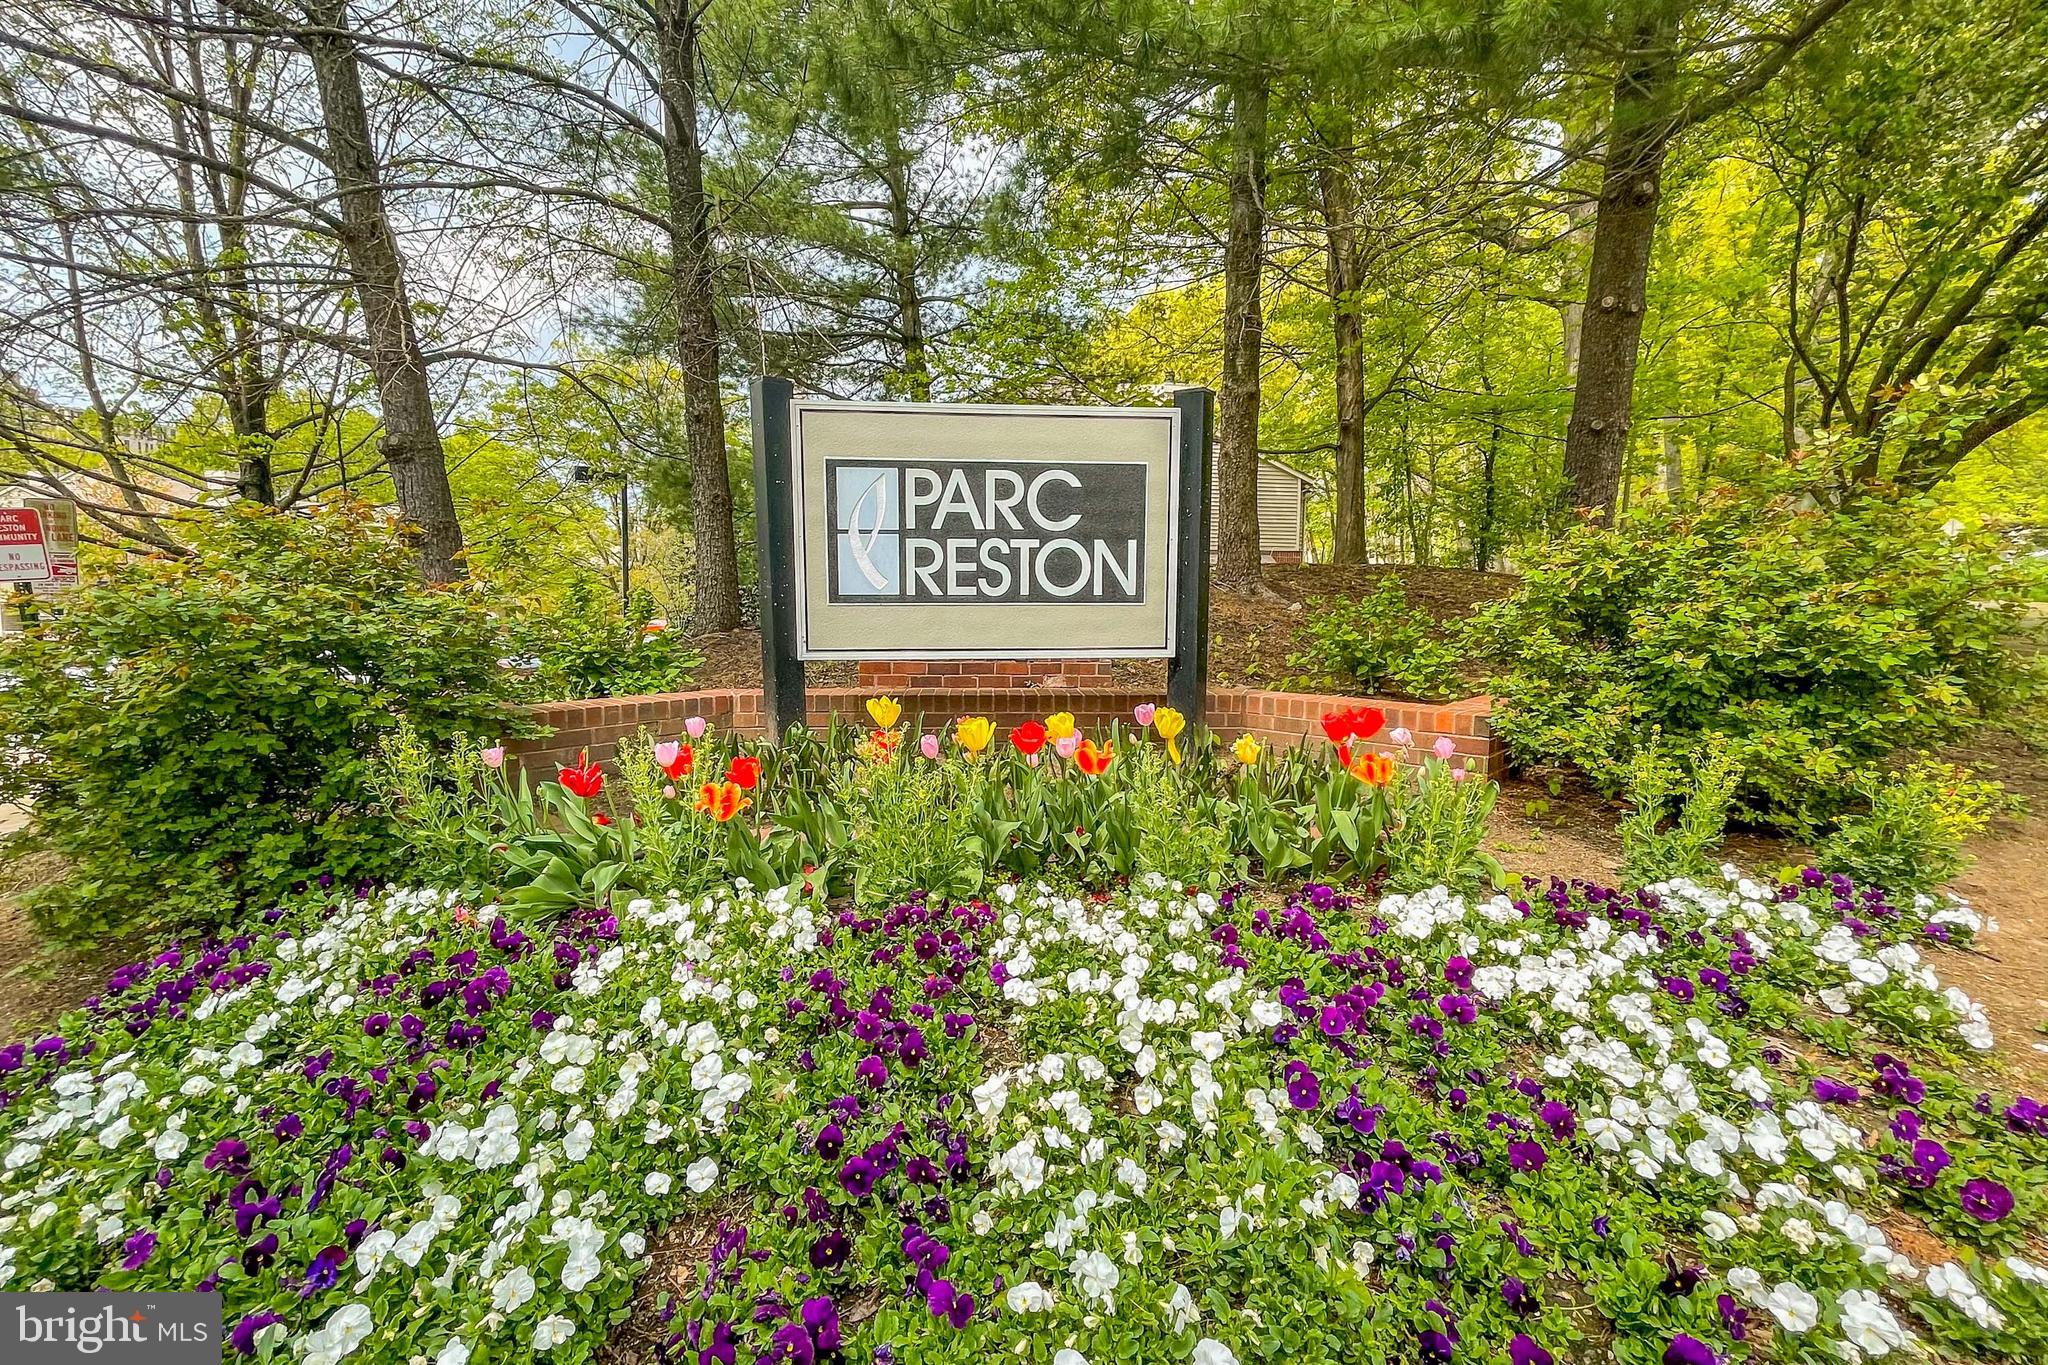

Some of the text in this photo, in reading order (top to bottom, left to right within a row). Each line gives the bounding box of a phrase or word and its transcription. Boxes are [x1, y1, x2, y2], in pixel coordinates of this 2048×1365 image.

[905, 468, 1083, 532] PARC
[0, 514, 19, 523] ARC
[8, 552, 21, 561] NO
[905, 538, 1138, 597] RESTON
